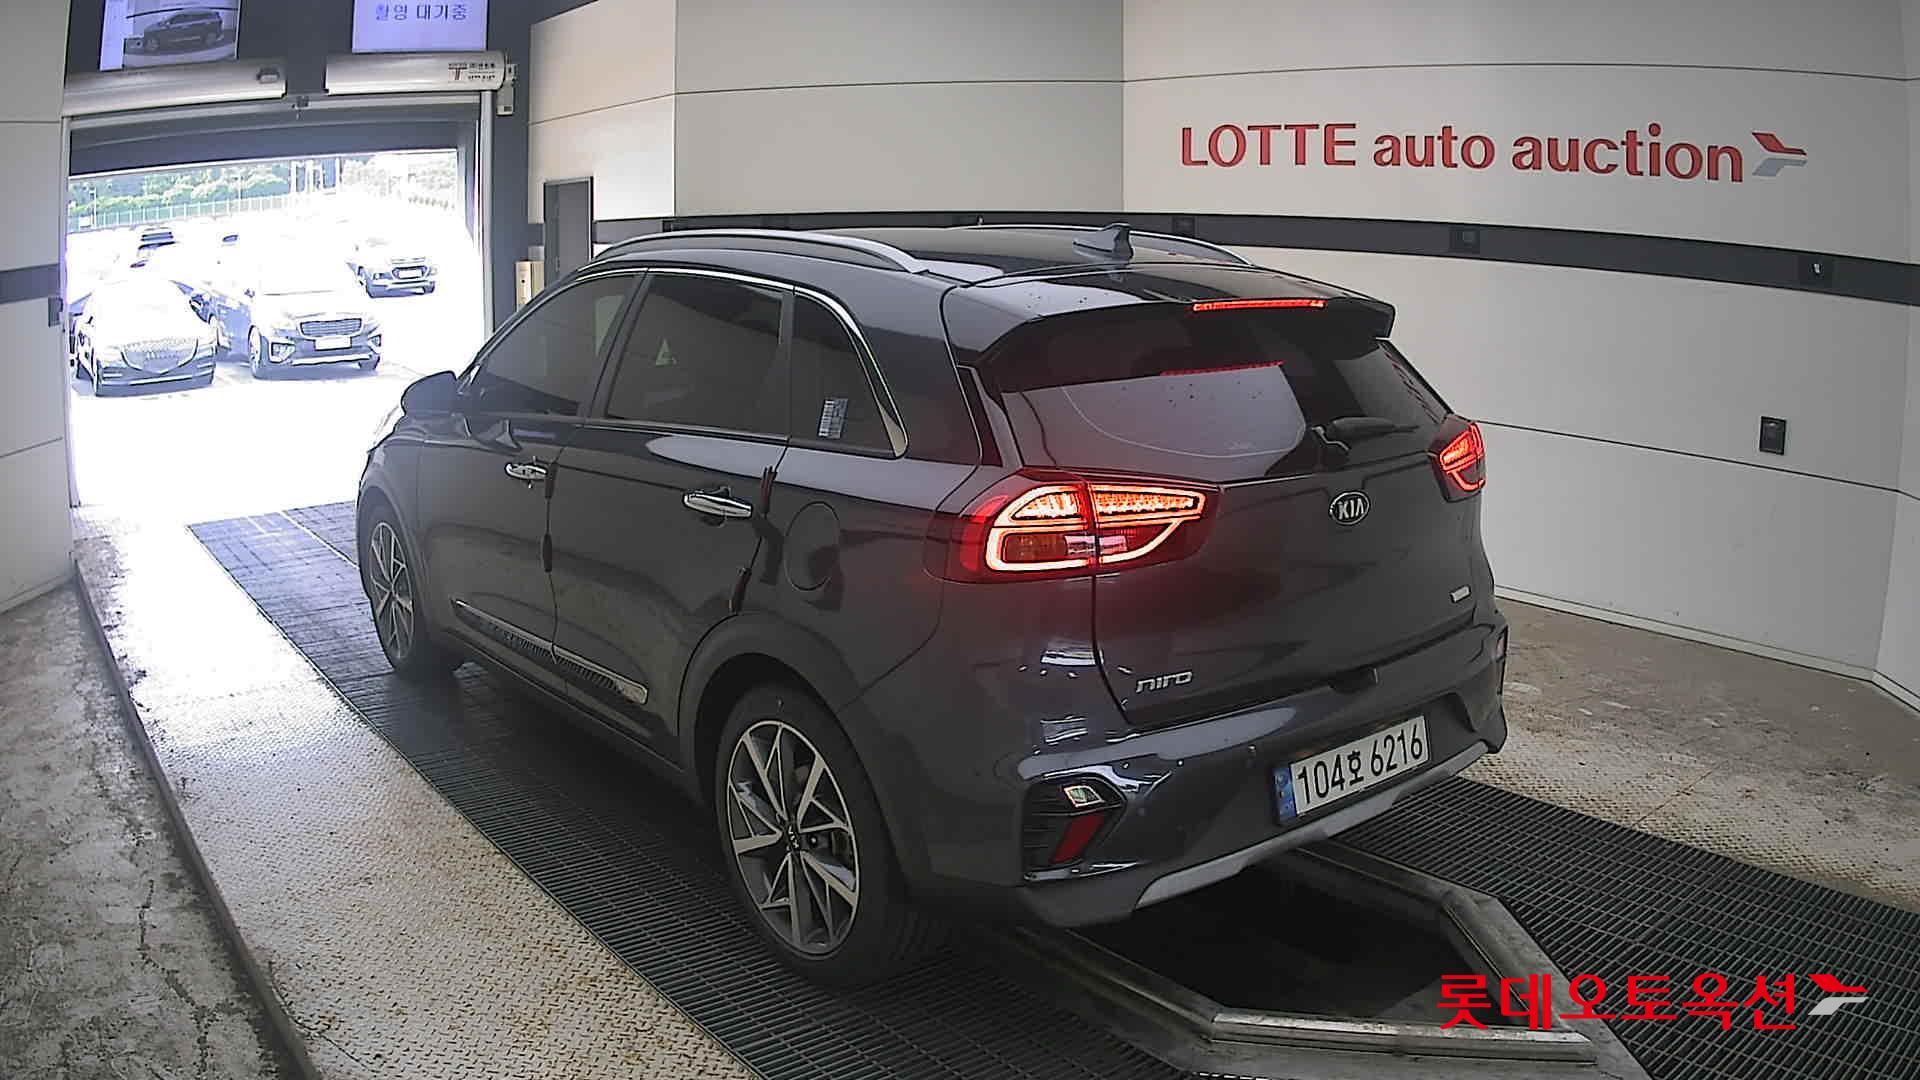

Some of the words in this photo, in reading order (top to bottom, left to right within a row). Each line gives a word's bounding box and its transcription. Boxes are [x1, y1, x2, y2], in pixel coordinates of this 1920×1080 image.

[416, 4, 467, 21] 대기중
[1181, 122, 1357, 168] LOTTE
[1373, 124, 1496, 169] auto
[1511, 122, 1744, 184] auction
[1334, 496, 1366, 521] KIA
[1297, 750, 1365, 805] 104호
[1369, 724, 1424, 777] 6216
